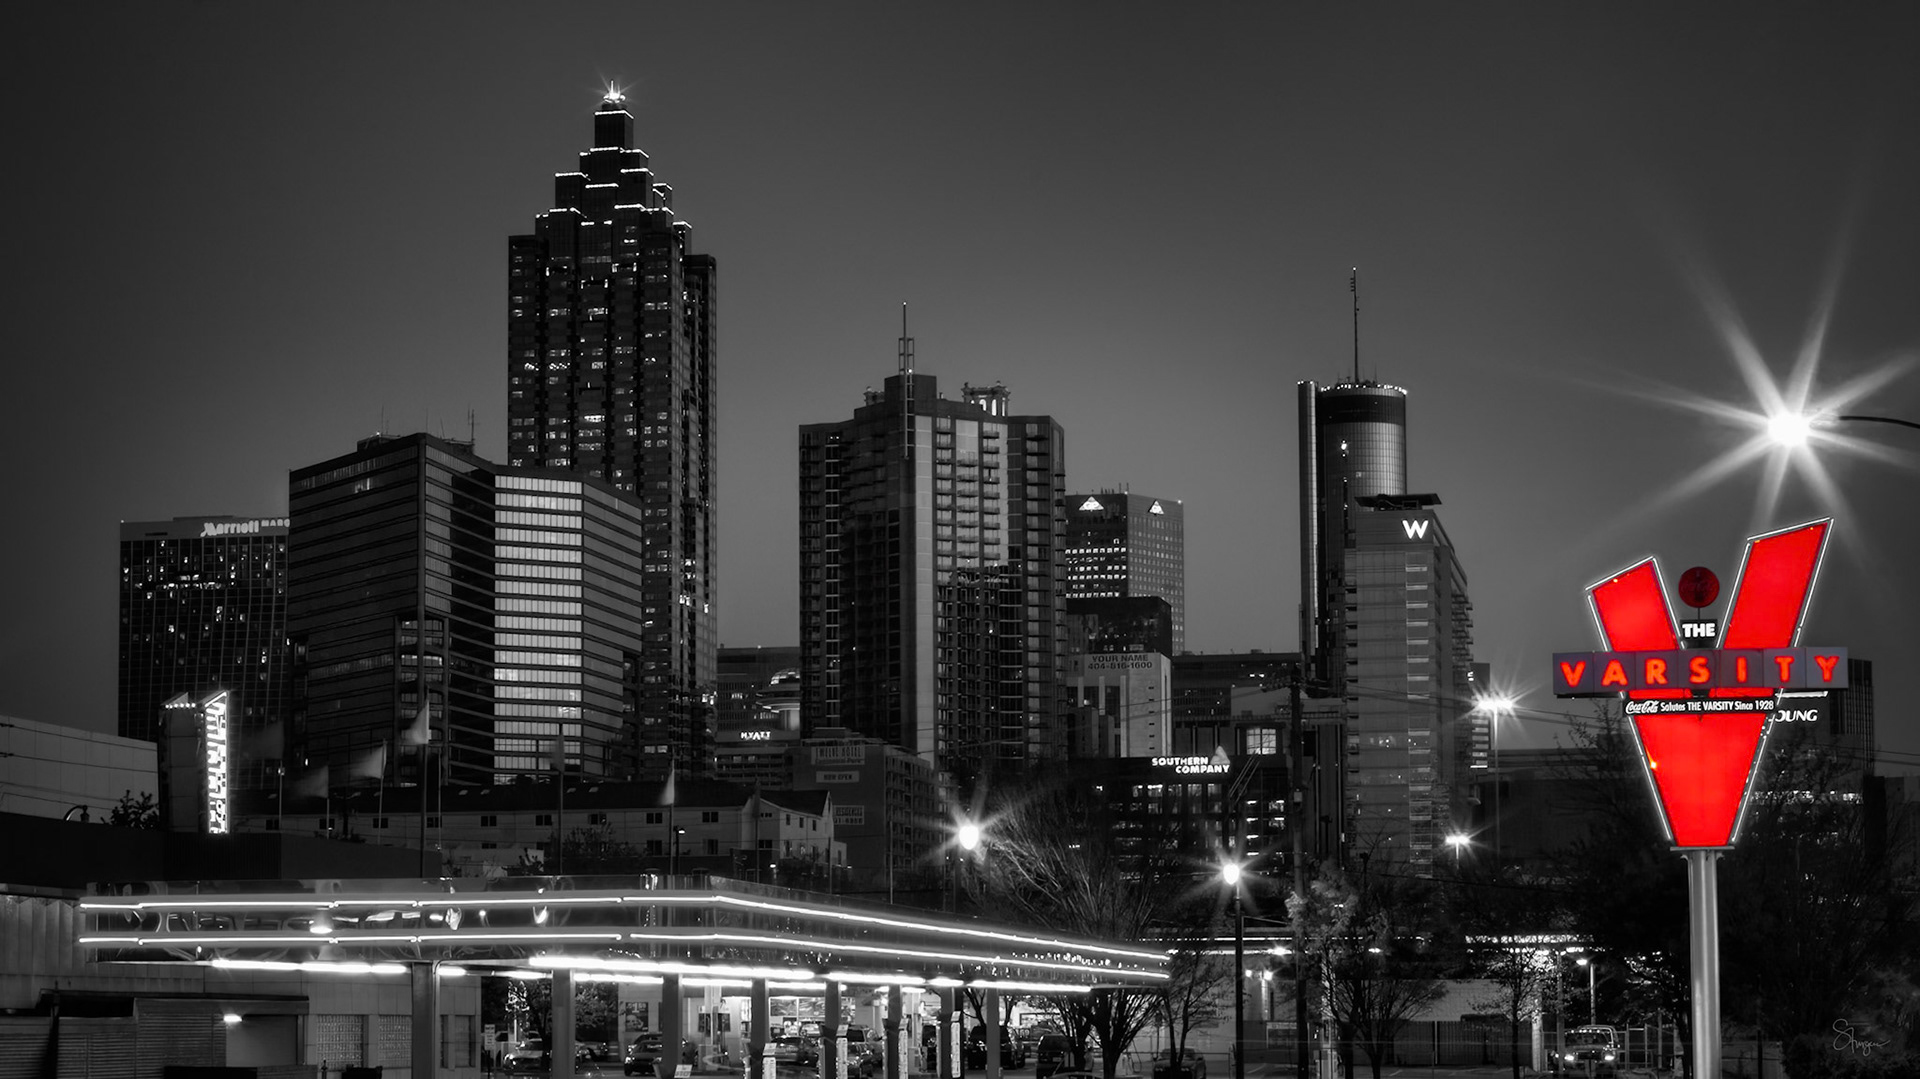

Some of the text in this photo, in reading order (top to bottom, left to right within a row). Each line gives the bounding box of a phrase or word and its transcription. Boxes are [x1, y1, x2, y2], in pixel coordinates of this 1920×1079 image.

[200, 520, 259, 537] Marriott
[1402, 520, 1428, 539] W
[1682, 622, 1716, 638] THE
[1121, 654, 1149, 662] NAME
[1559, 654, 1840, 688] VARSITY
[1626, 700, 1774, 714] Coca-Cola Salutes THE VARSITY Since 1928
[740, 731, 771, 740] HYATT
[1151, 757, 1209, 766] SOUTHERN
[1175, 765, 1230, 774] COMPANY
